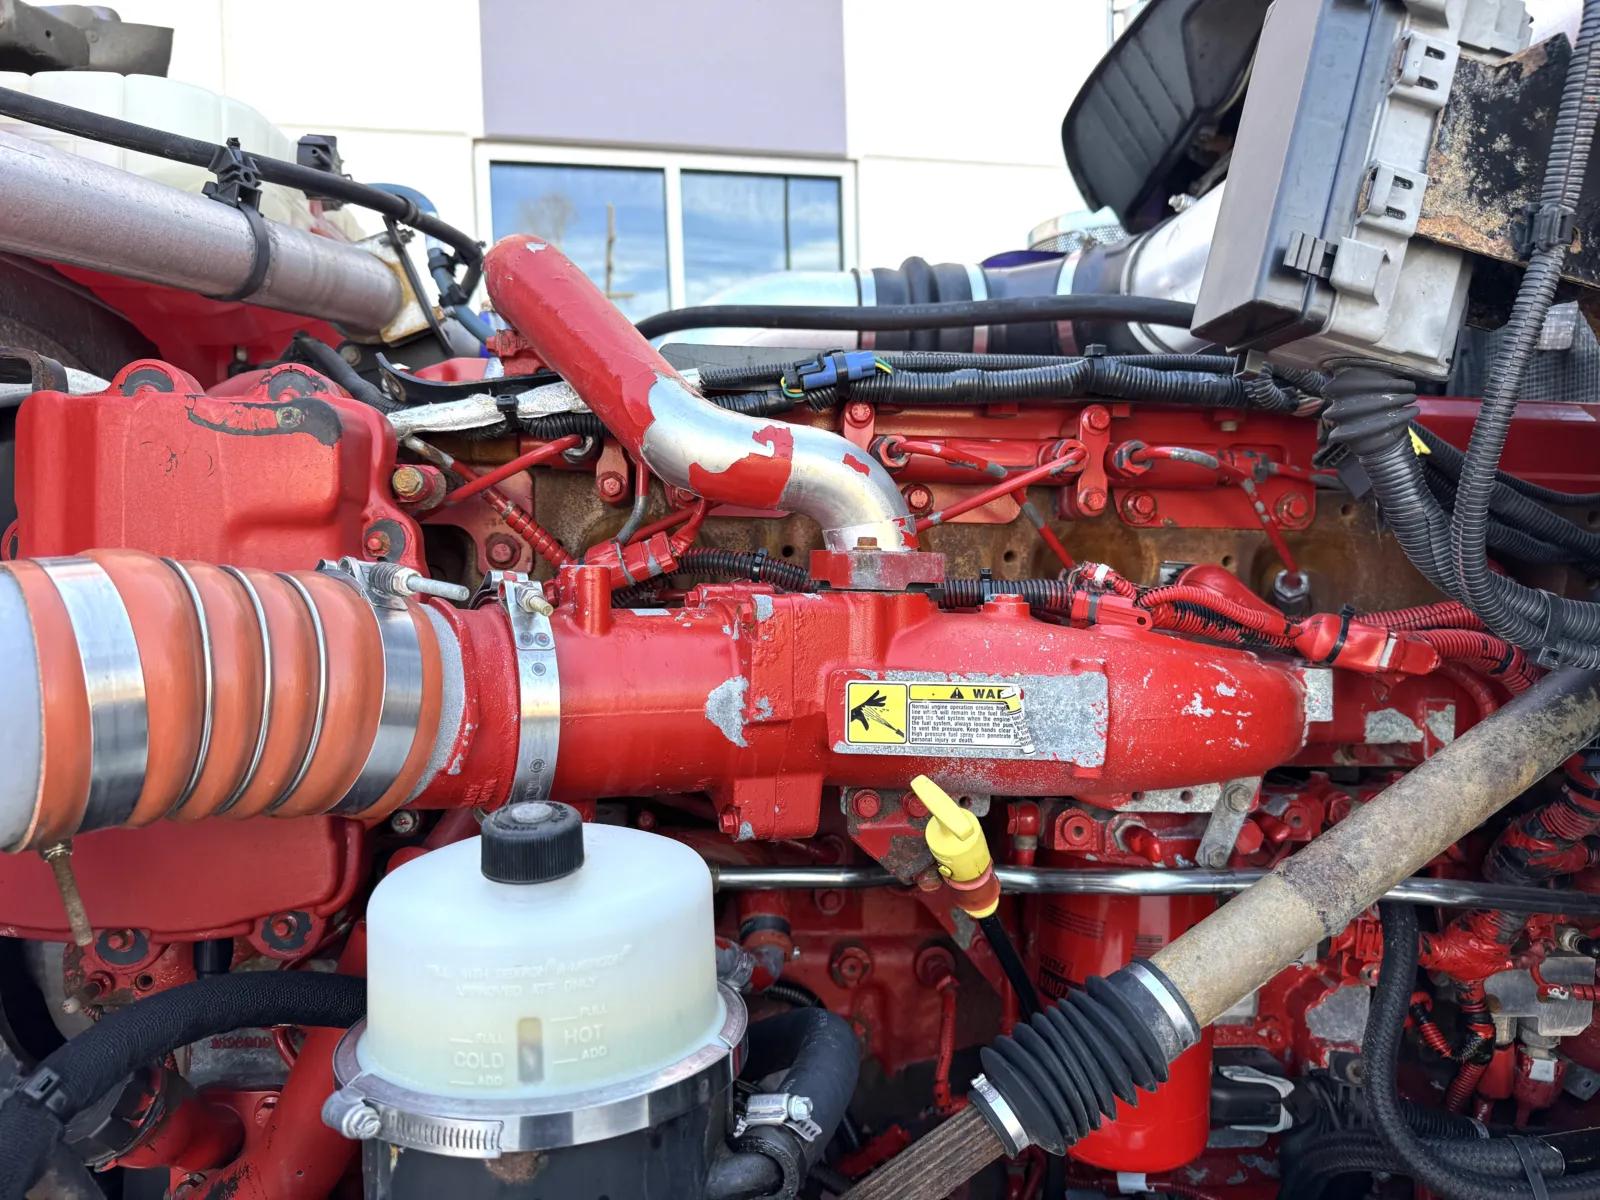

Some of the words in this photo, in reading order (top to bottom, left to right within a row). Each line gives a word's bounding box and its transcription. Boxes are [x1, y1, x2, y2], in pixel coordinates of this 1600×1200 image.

[564, 1023, 604, 1045] HOT
[454, 1051, 505, 1069] COLD
[581, 1045, 608, 1060] ADD
[476, 1075, 503, 1087] ADD
